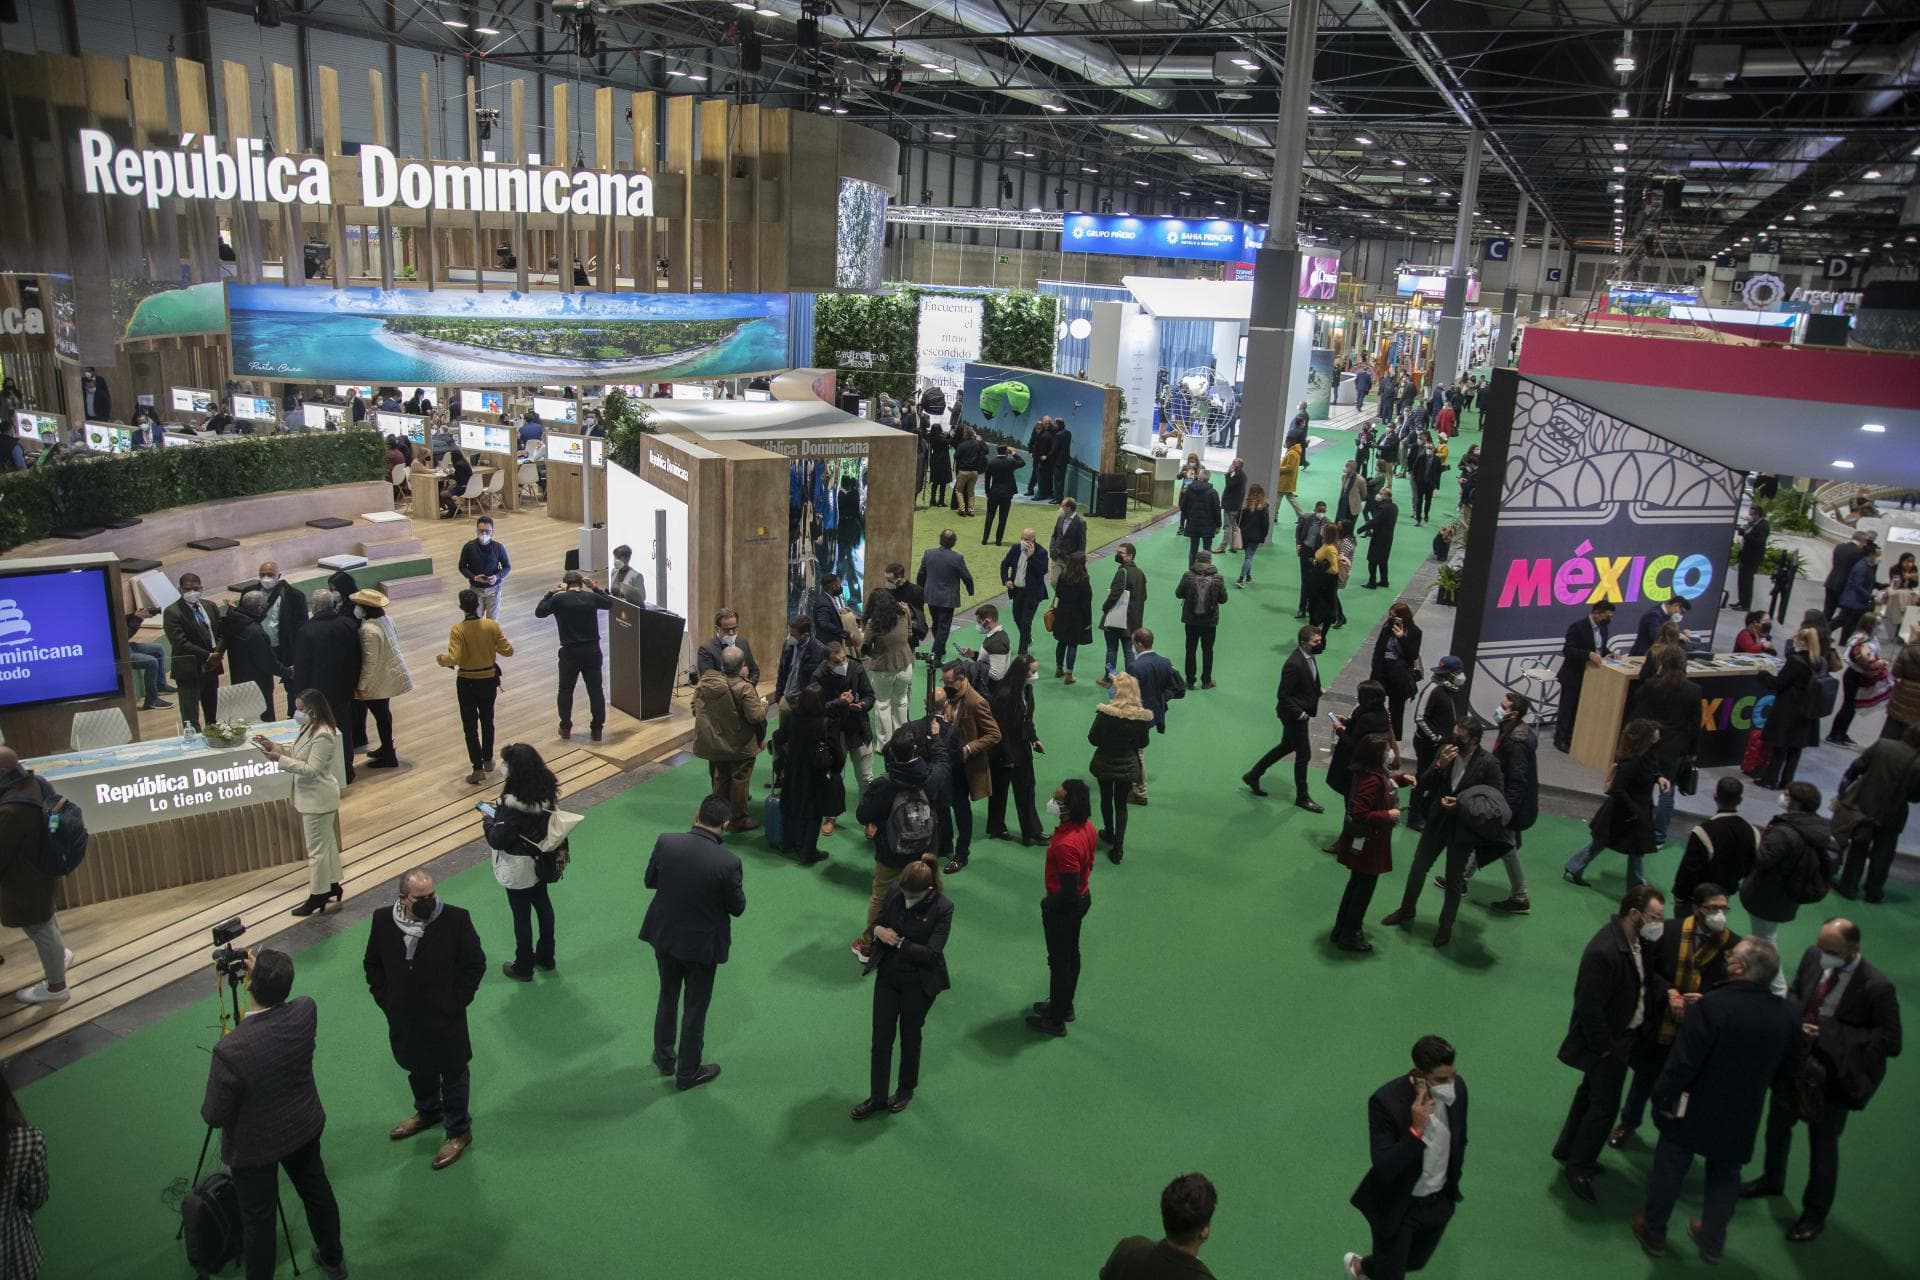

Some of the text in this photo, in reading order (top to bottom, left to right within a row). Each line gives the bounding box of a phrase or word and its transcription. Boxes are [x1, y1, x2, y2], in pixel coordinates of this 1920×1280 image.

[80, 128, 654, 217] República Dominicana
[1086, 229, 1110, 238] GRUPO
[1490, 241, 1505, 258] C
[1769, 240, 1779, 252] 3
[1728, 257, 1736, 267] 3
[1828, 258, 1848, 277] D
[1550, 270, 1559, 280] C
[1734, 281, 1745, 292] D
[924, 300, 973, 314] Encuentra
[964, 318, 973, 329] el
[922, 347, 971, 359] escondido
[943, 362, 955, 372] de
[801, 439, 869, 456] Dominicana
[0, 644, 84, 666] minicana
[95, 772, 190, 804] República
[149, 783, 252, 812] Lo tiene todo
